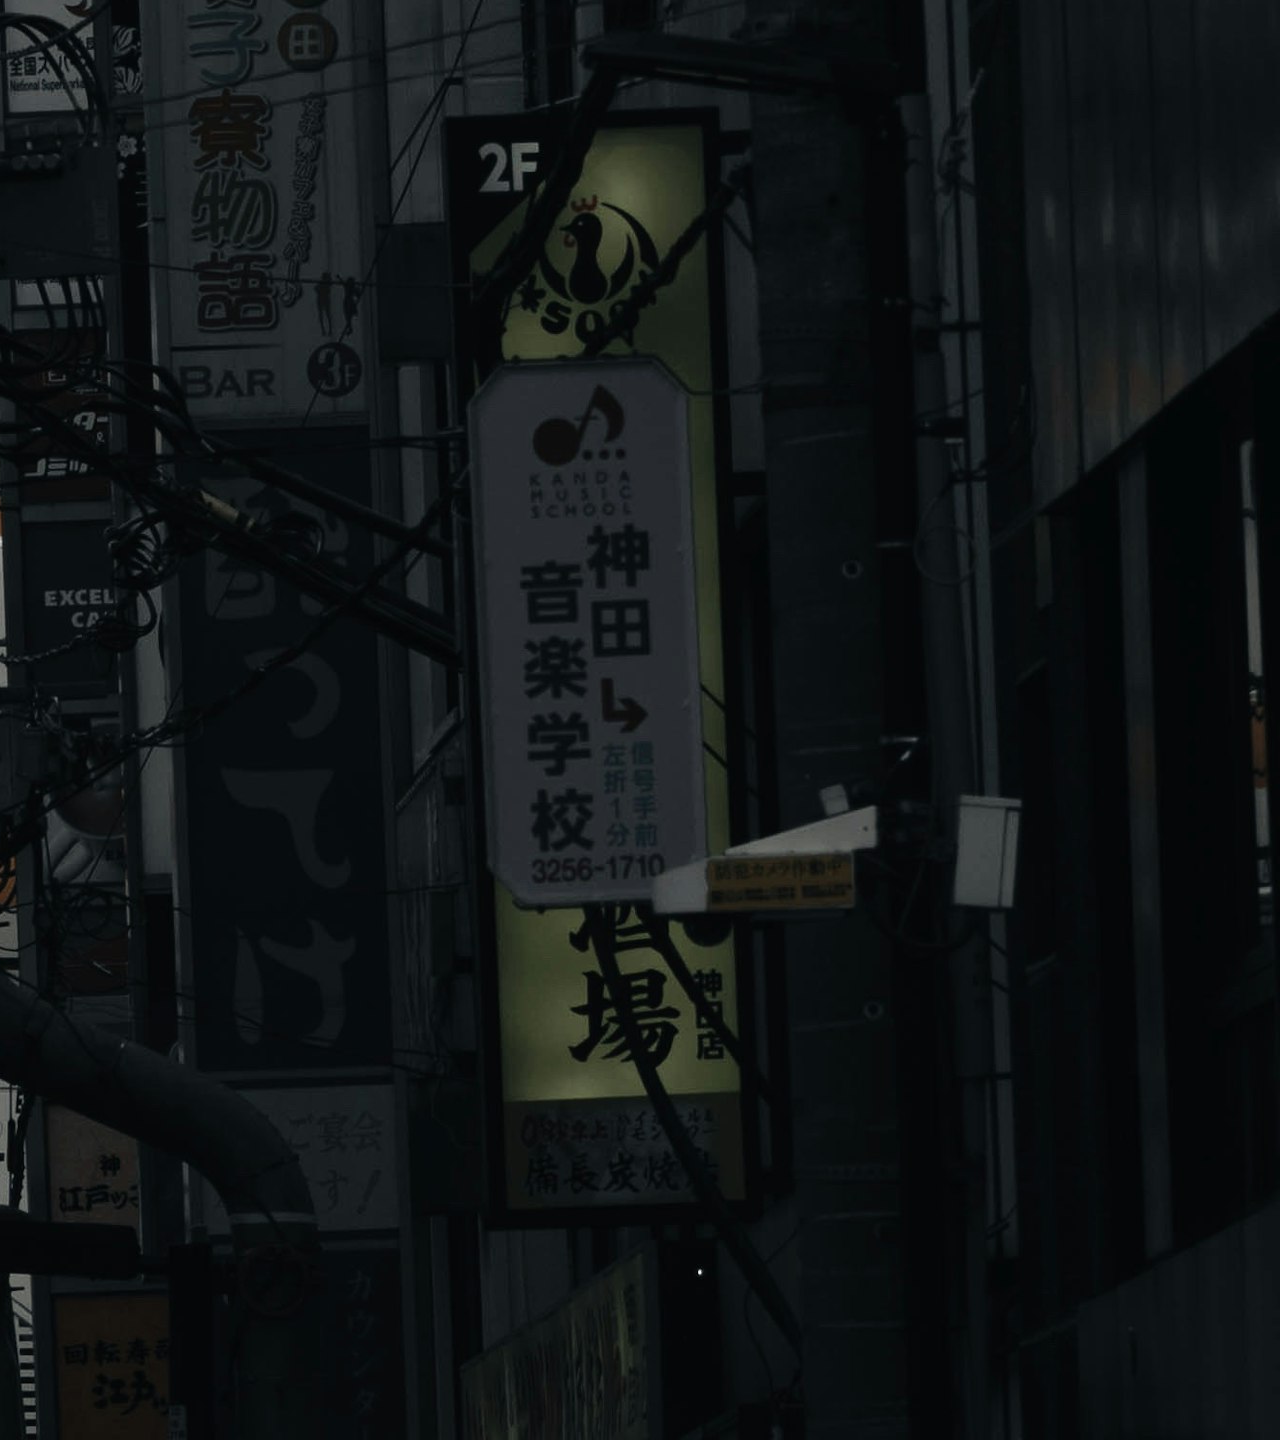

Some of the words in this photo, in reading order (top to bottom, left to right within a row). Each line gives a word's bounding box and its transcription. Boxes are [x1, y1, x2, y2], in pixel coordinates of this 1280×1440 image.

[478, 142, 539, 192] 2F
[530, 471, 631, 486] KANDA
[530, 487, 633, 502] MUSIC
[530, 503, 633, 519] SCHOOL
[588, 523, 652, 657] 神田
[520, 560, 593, 852] 音楽学校
[531, 853, 665, 884] 3256-1710
